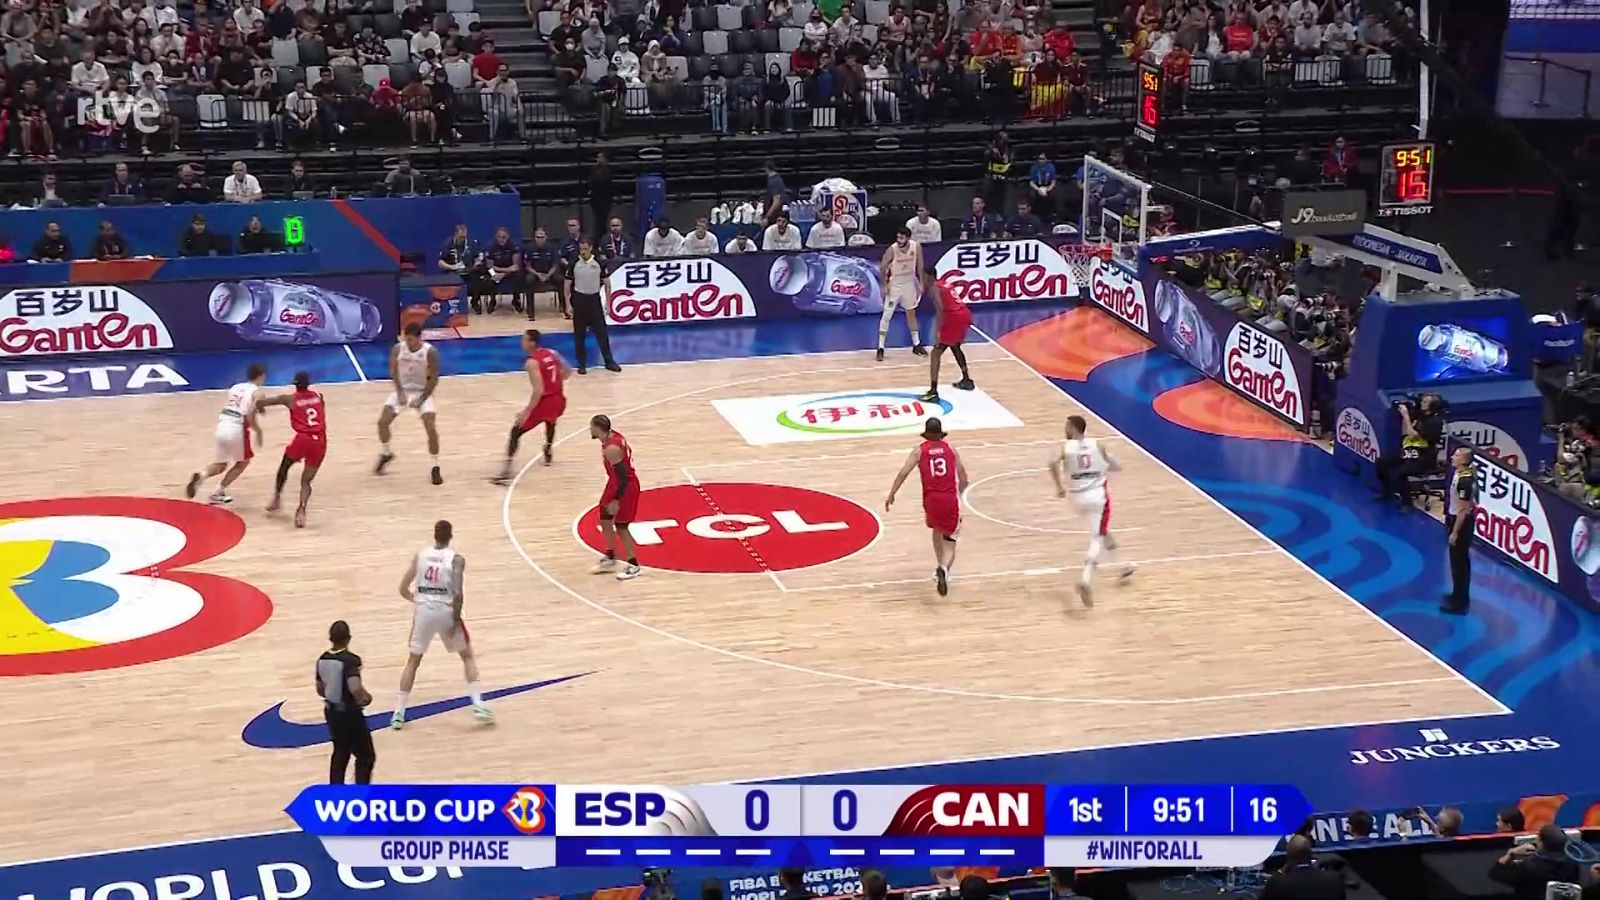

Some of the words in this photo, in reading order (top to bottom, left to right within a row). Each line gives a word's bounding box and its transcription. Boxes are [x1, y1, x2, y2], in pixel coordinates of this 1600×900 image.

[1396, 150, 1431, 167] 9:51
[1392, 206, 1434, 216] TISSOT
[957, 243, 1040, 269] 百岁山
[625, 262, 712, 289] 百岁山
[14, 289, 119, 317] 百岁山
[1238, 324, 1284, 370] 百岁山
[305, 408, 320, 427] 2
[801, 401, 925, 424] 伊利
[929, 457, 947, 477] 13
[596, 508, 850, 546] TCL
[1350, 735, 1561, 765] JUNCKERS
[729, 877, 768, 892] FIBA
